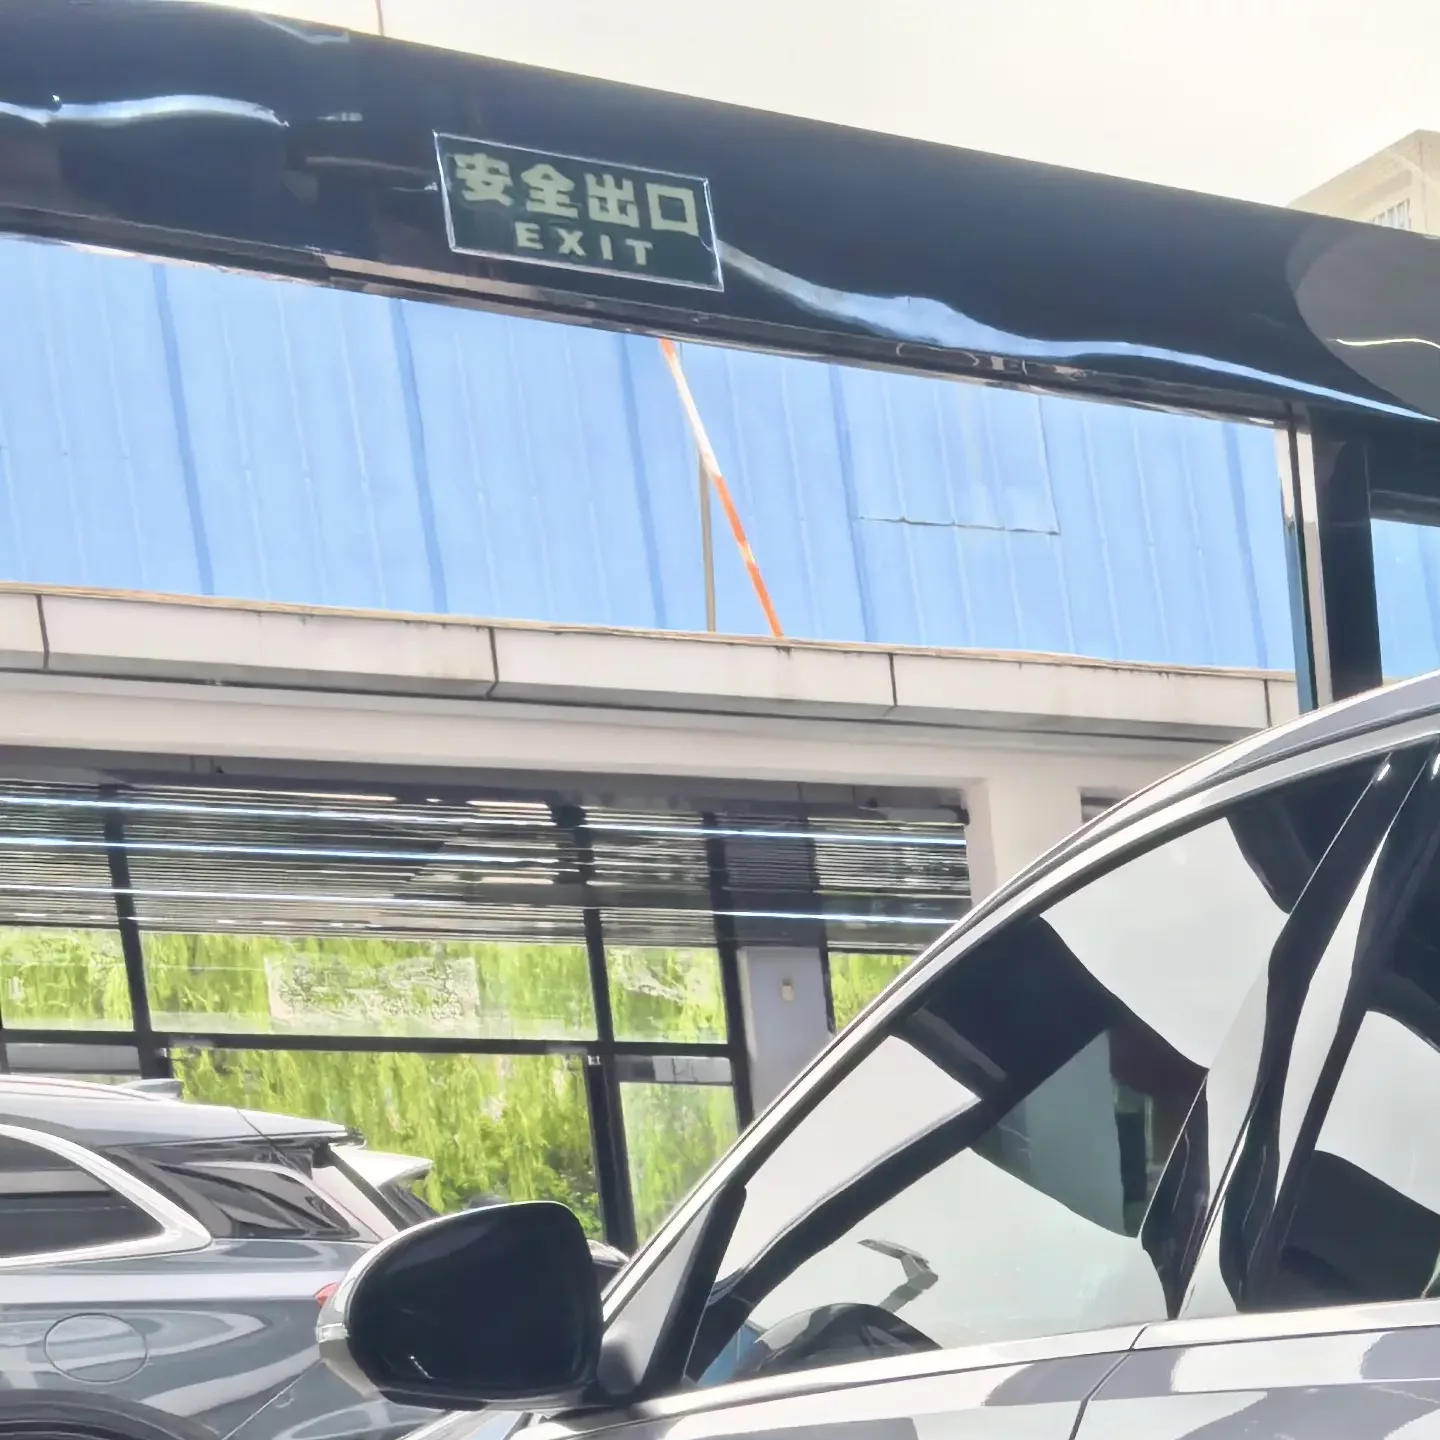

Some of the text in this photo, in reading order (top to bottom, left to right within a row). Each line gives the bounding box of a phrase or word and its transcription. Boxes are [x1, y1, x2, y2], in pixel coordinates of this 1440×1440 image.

[452, 151, 699, 237] 安全出口
[514, 221, 654, 266] EXIT
